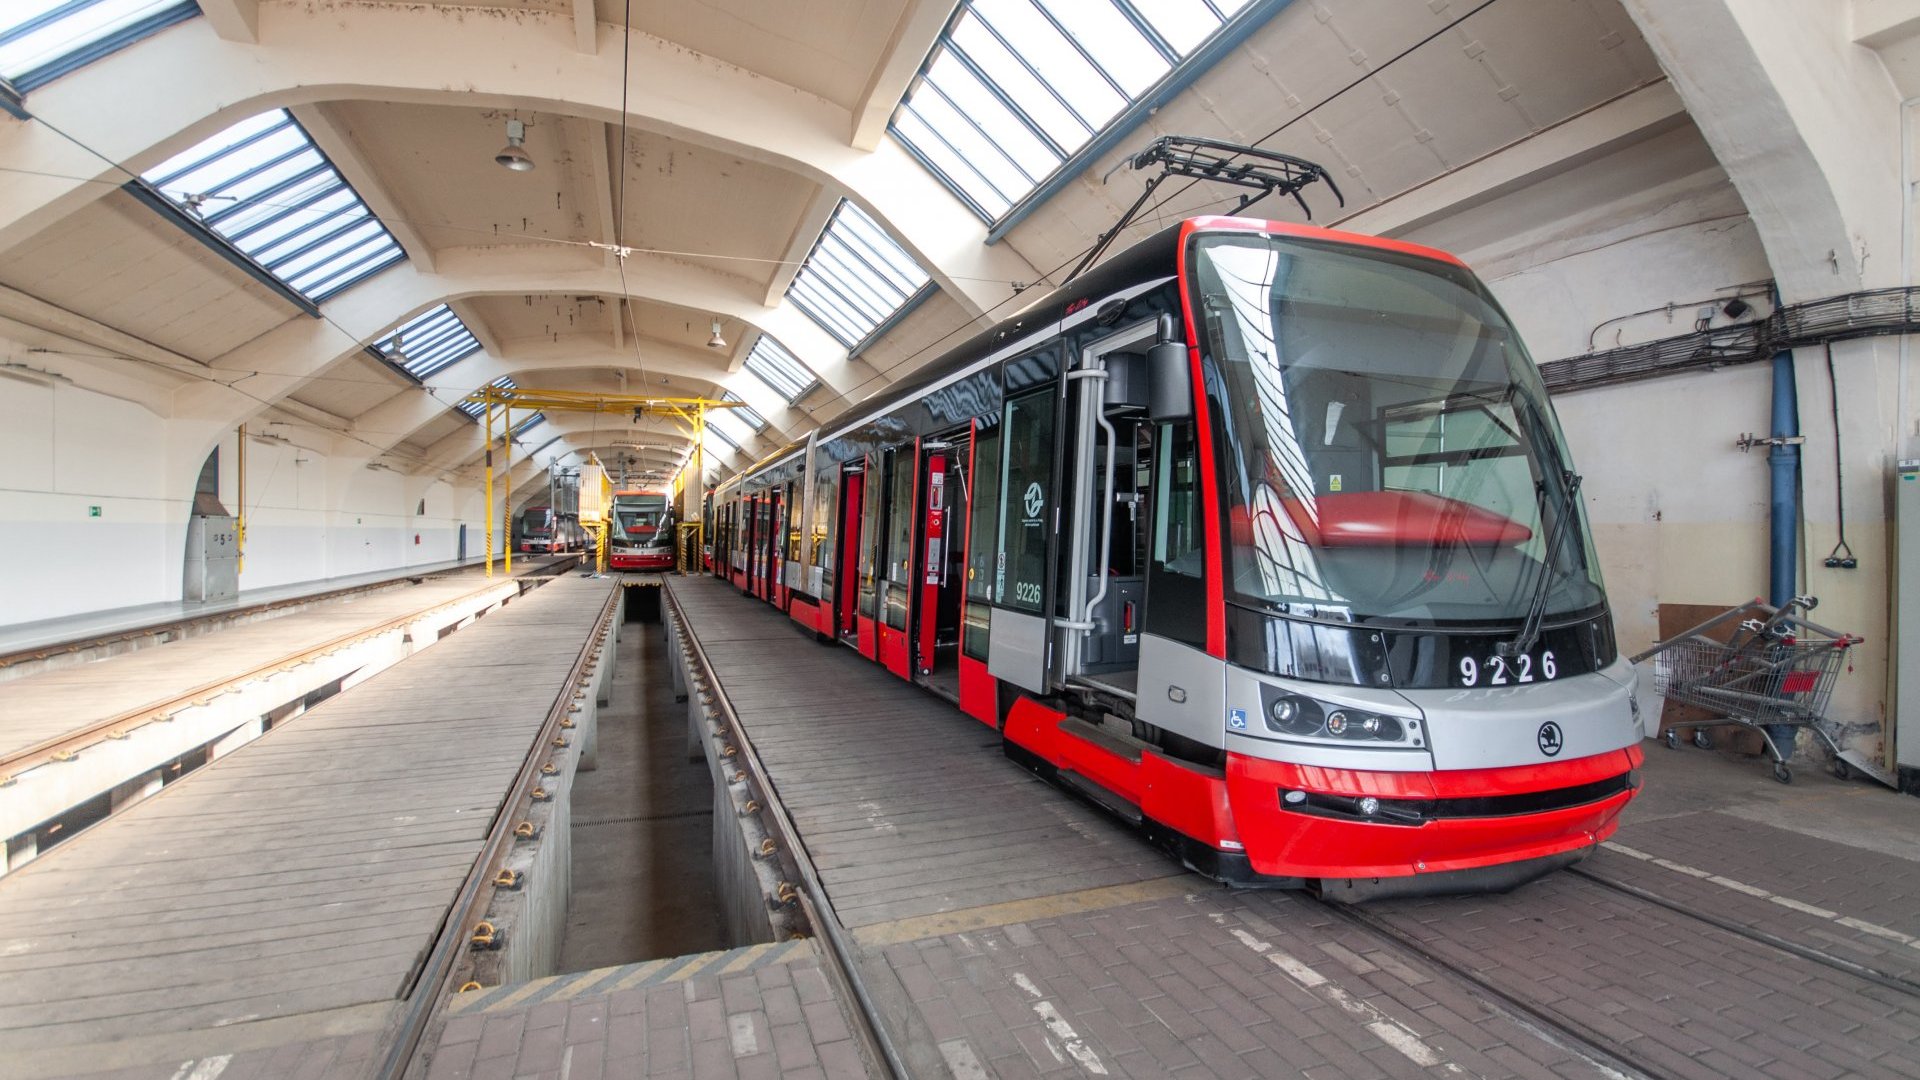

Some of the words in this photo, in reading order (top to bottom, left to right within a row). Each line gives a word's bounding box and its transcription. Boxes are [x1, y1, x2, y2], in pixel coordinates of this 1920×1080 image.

[220, 534, 225, 545] 5
[1016, 582, 1041, 604] 9226
[1460, 651, 1556, 686] 9226
